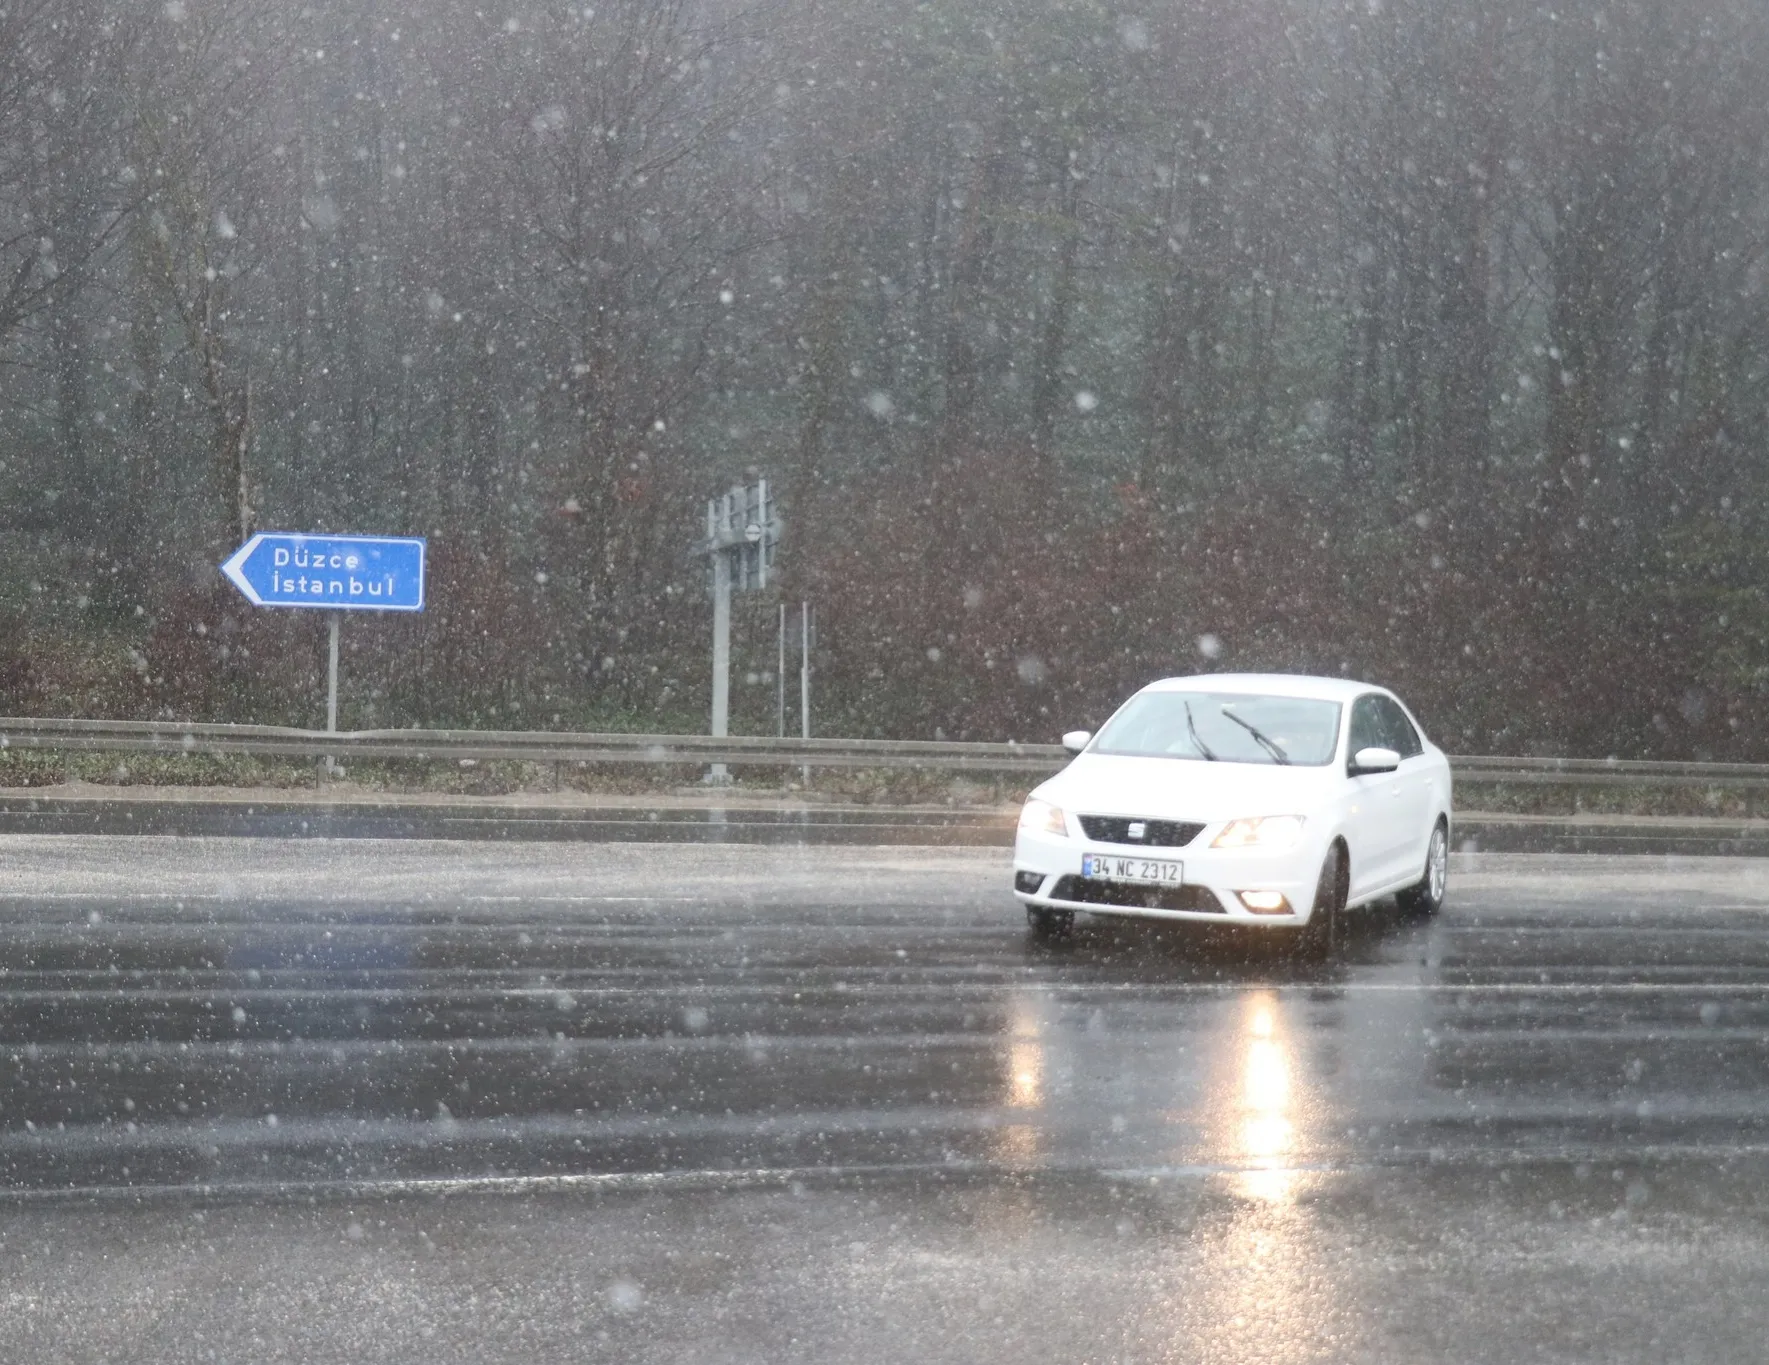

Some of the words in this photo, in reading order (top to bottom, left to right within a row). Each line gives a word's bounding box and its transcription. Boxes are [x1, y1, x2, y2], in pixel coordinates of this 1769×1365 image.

[274, 546, 359, 569] Düzce
[273, 571, 393, 596] İstanbul
[1093, 858, 1110, 875] 34
[1116, 860, 1134, 877] NC
[1141, 862, 1178, 881] 2312
